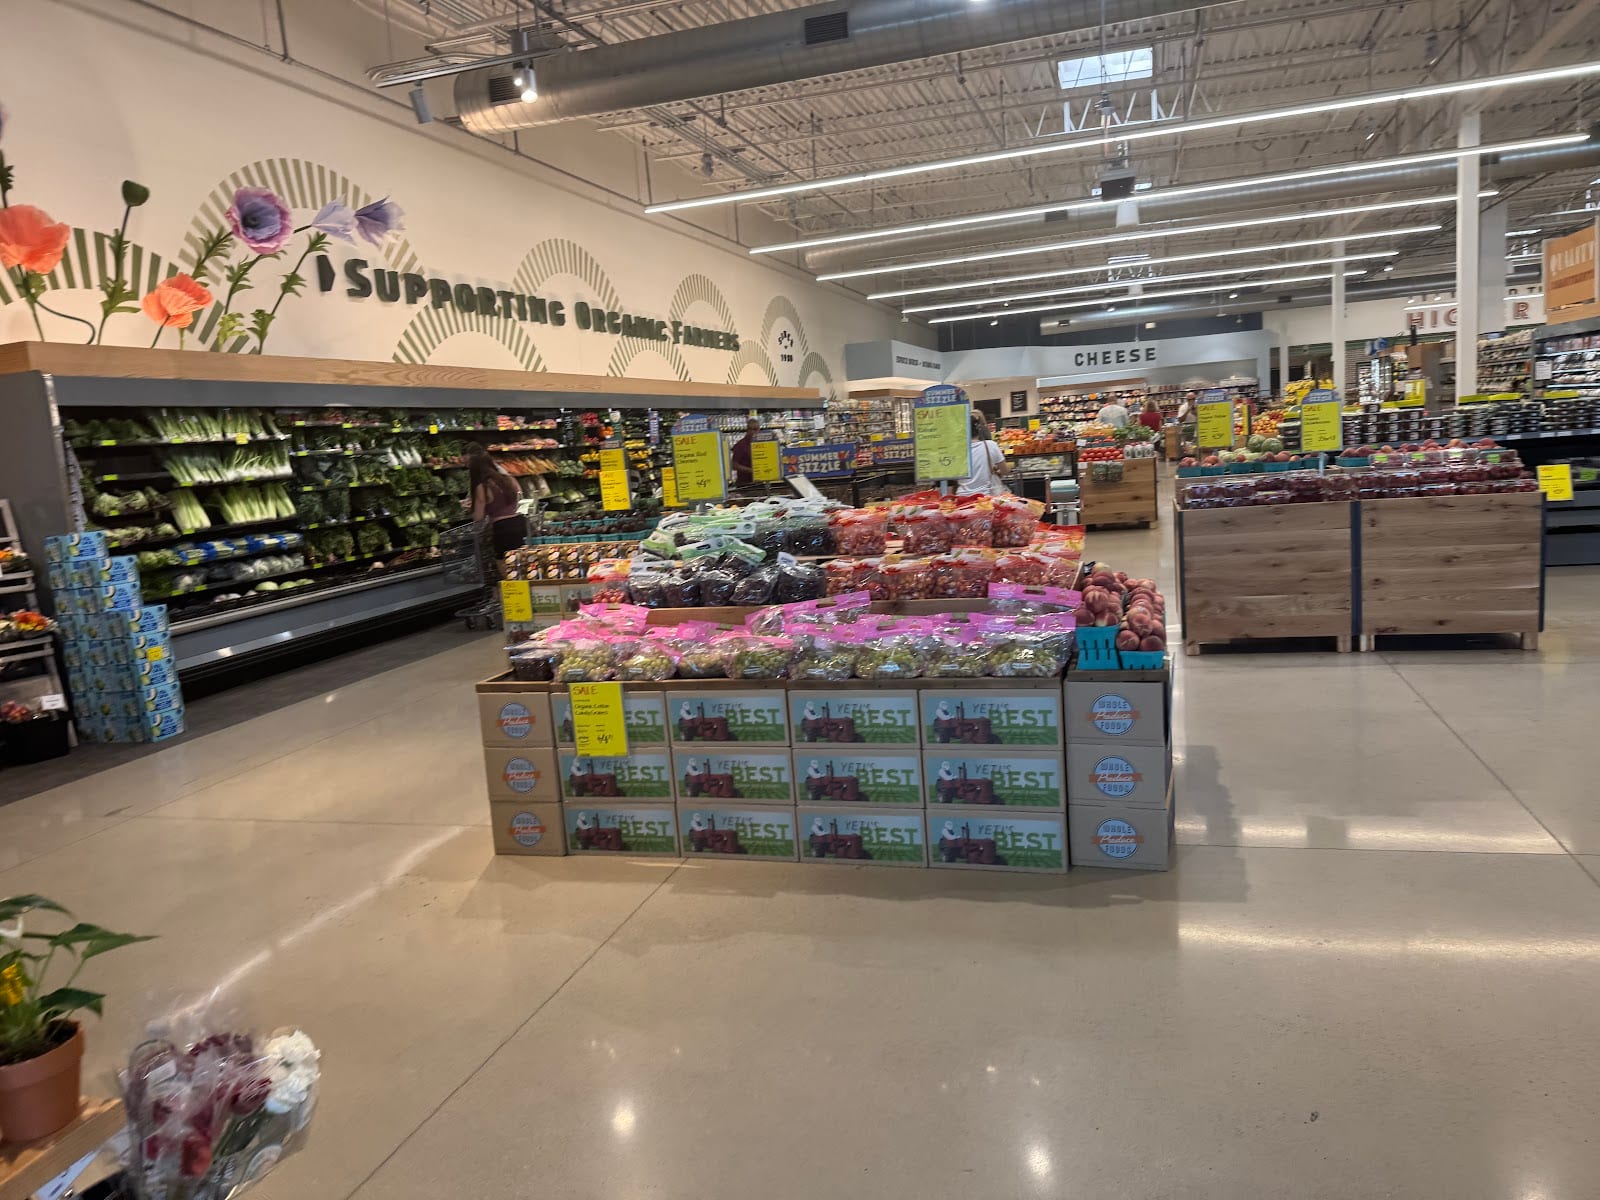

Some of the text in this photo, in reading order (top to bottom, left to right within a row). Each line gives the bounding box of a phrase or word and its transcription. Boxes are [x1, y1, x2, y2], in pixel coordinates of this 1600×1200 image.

[344, 258, 740, 351] SUPPORTING ORGANIC FARMERS
[1074, 347, 1157, 366] CHEESE
[798, 451, 839, 464] SUMMER
[798, 461, 841, 473] SIZZLE
[572, 685, 598, 696] SALE
[1098, 700, 1128, 709] WHOLE
[625, 710, 660, 726] EST
[725, 708, 780, 725] BEST
[852, 708, 911, 726] BEST
[989, 709, 1053, 727] BEST
[1095, 711, 1131, 720] Produce
[1100, 721, 1128, 730] FOODS
[614, 765, 665, 781] BEST
[731, 766, 785, 782] BEST
[856, 768, 915, 786] BEST
[991, 770, 1055, 788] BEST
[619, 821, 670, 837] BEST
[735, 822, 790, 840] BEST
[860, 827, 918, 845] BEST
[994, 831, 1057, 850] BEST
